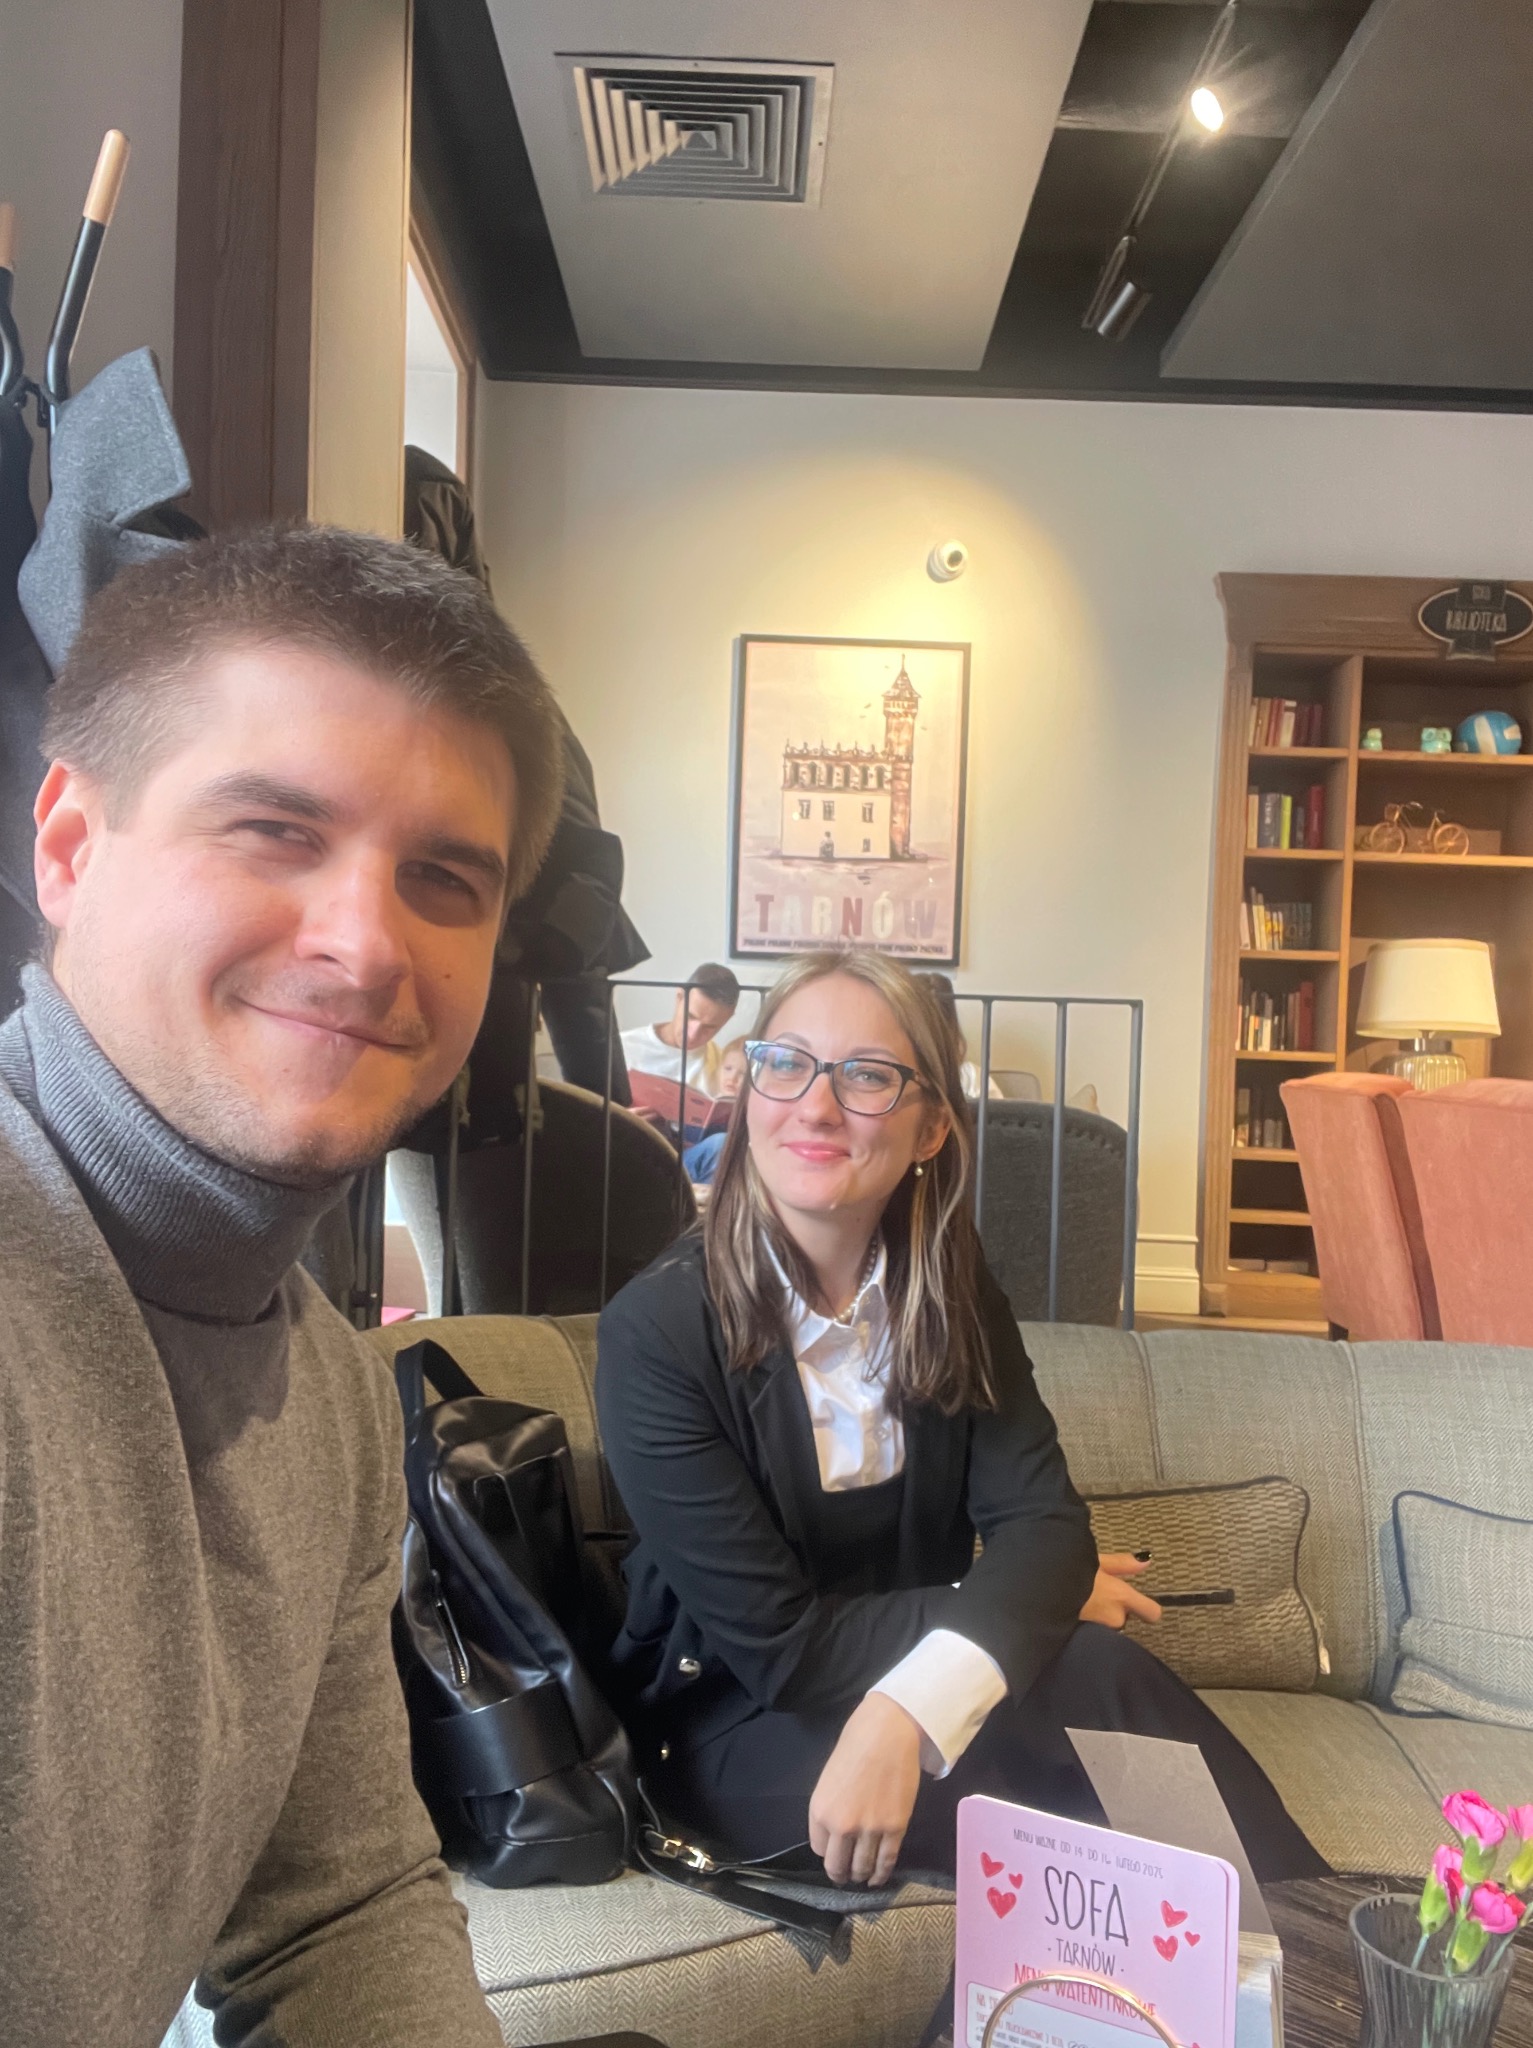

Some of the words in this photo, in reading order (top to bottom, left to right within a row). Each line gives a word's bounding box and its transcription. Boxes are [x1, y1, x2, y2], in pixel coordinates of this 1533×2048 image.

[755, 891, 938, 940] TARNÓW
[1013, 1828, 1034, 1844] MENU
[1060, 1841, 1071, 1854] OD
[1087, 1848, 1099, 1862] DO
[1142, 1863, 1164, 1879] 2025
[1044, 1866, 1129, 1947] SOFA
[1056, 1937, 1116, 1977] TARNÓW
